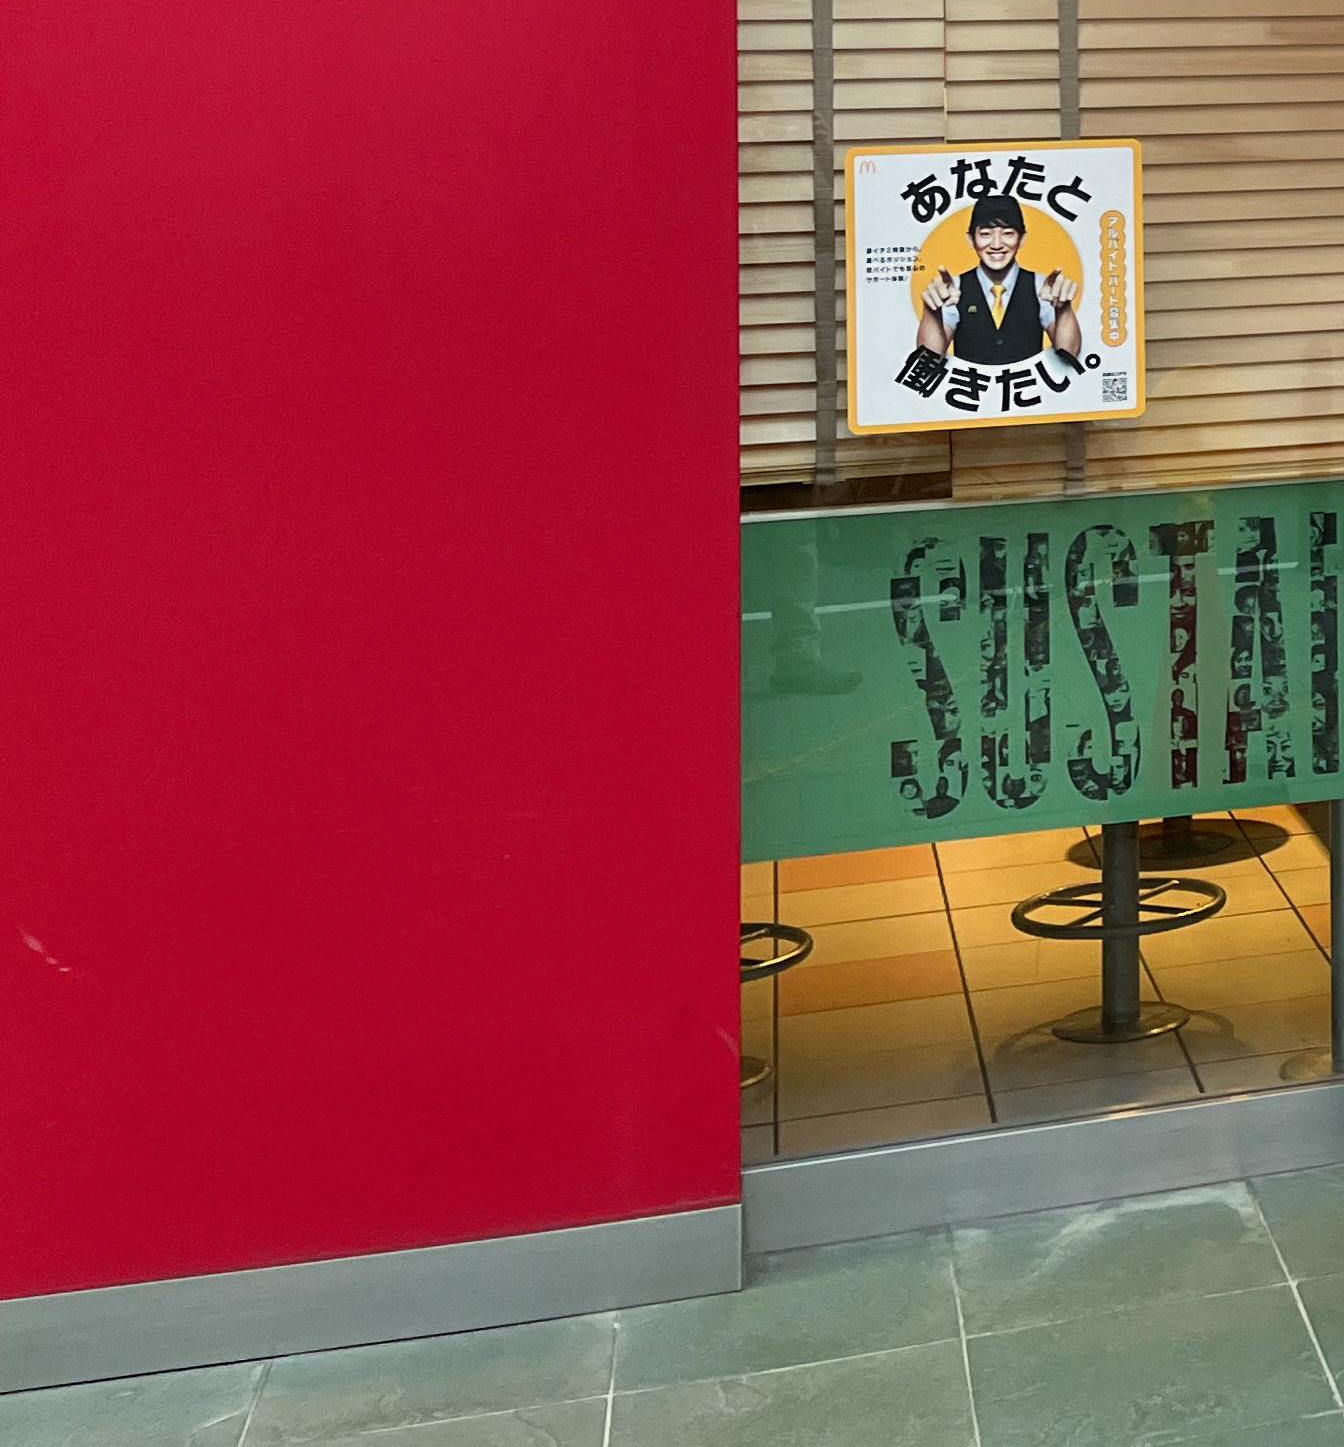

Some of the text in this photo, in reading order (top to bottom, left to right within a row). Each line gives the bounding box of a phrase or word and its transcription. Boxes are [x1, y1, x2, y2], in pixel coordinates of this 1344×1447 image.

[900, 155, 1093, 224] あなたと
[894, 344, 1102, 413] 働きたい。
